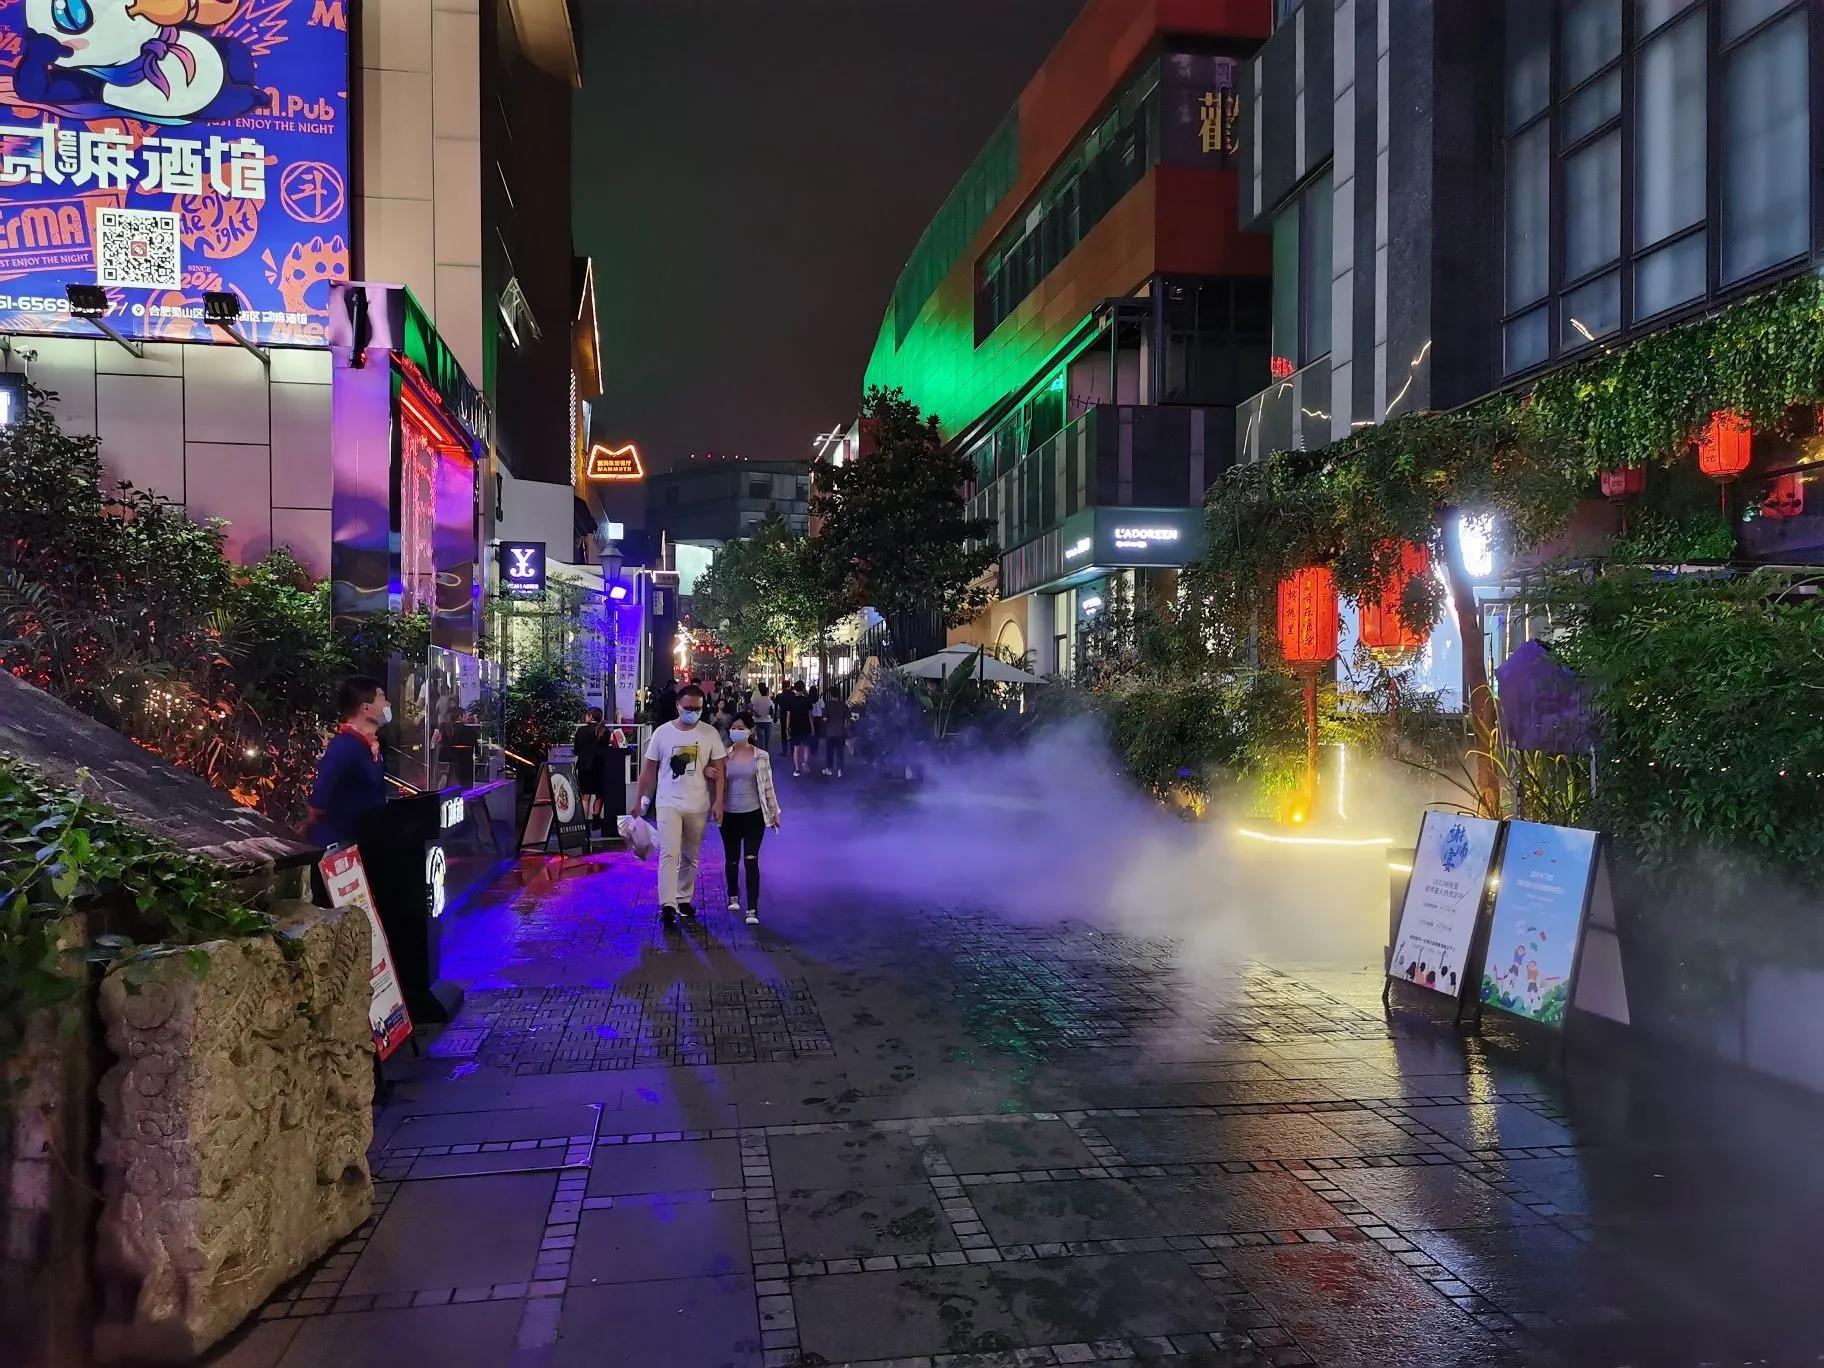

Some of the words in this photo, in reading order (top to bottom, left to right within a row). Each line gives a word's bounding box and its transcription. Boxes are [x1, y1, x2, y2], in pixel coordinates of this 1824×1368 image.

[235, 118, 272, 130] ENJOY
[274, 120, 296, 132] THE
[298, 122, 335, 135] NIGHT
[12, 257, 41, 267] ENJOY
[41, 255, 60, 265] THE
[60, 252, 89, 264] NIGHT
[187, 264, 212, 273] SINCE
